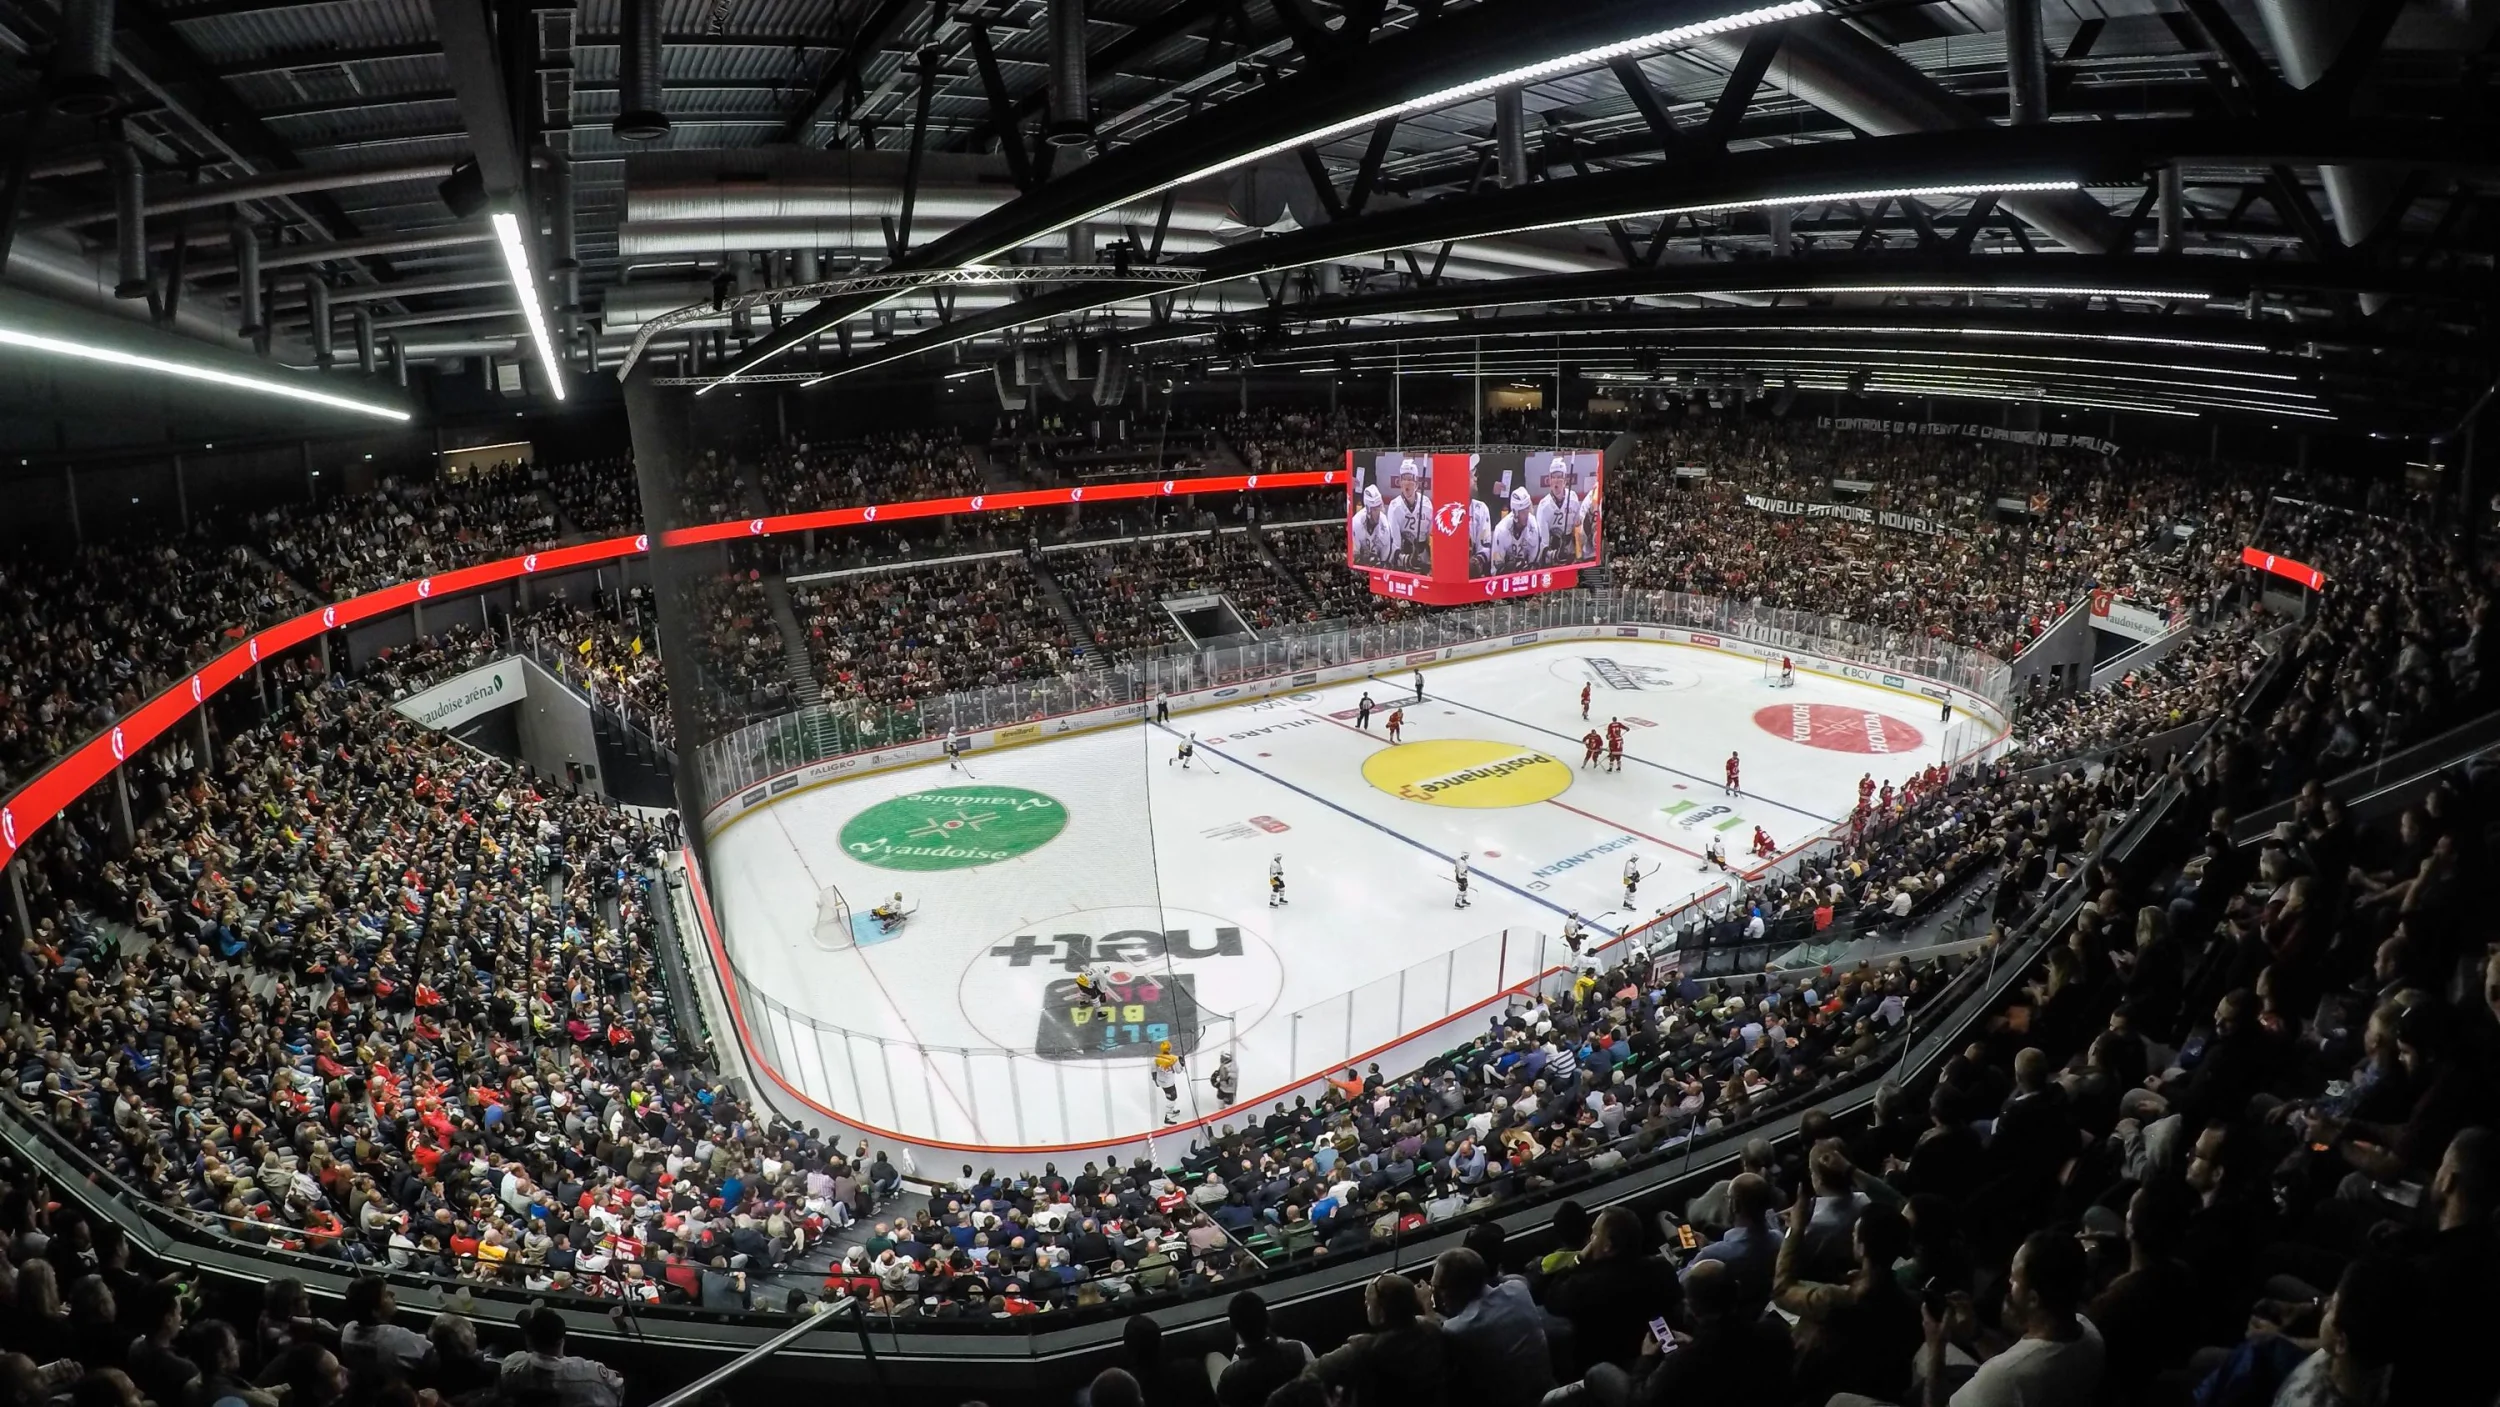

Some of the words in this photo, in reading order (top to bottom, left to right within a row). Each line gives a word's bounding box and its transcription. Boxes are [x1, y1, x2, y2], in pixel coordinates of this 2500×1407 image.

[1818, 416, 1831, 428] LE
[1962, 424, 1978, 437] LE
[2070, 435, 2120, 457] MALLEY
[1404, 516, 1416, 530] 72
[1554, 512, 1564, 526] 72
[1745, 494, 1803, 514] NOUVELLE
[1879, 511, 1945, 537] NOUVELLE
[1502, 578, 1509, 592] 0
[1531, 574, 1537, 588] 0
[2106, 615, 2143, 632] vaudoise
[1513, 634, 1537, 645] SAMSUNG
[1851, 668, 1871, 680] BCV
[419, 697, 463, 724] vaudoise
[465, 687, 494, 706] aréna
[1113, 704, 1149, 718] pacteam
[1228, 718, 1321, 740] VILLARS
[1792, 704, 1811, 742] HONDA
[1864, 713, 1889, 753] HONDA
[1420, 754, 1552, 793] PostFinance
[906, 793, 1018, 806] vaudoise
[885, 845, 1008, 860] vaudoise
[1532, 835, 1639, 879] HIRSLANDEN
[990, 927, 1244, 972] net+
[1070, 1005, 1145, 1027] BLA
